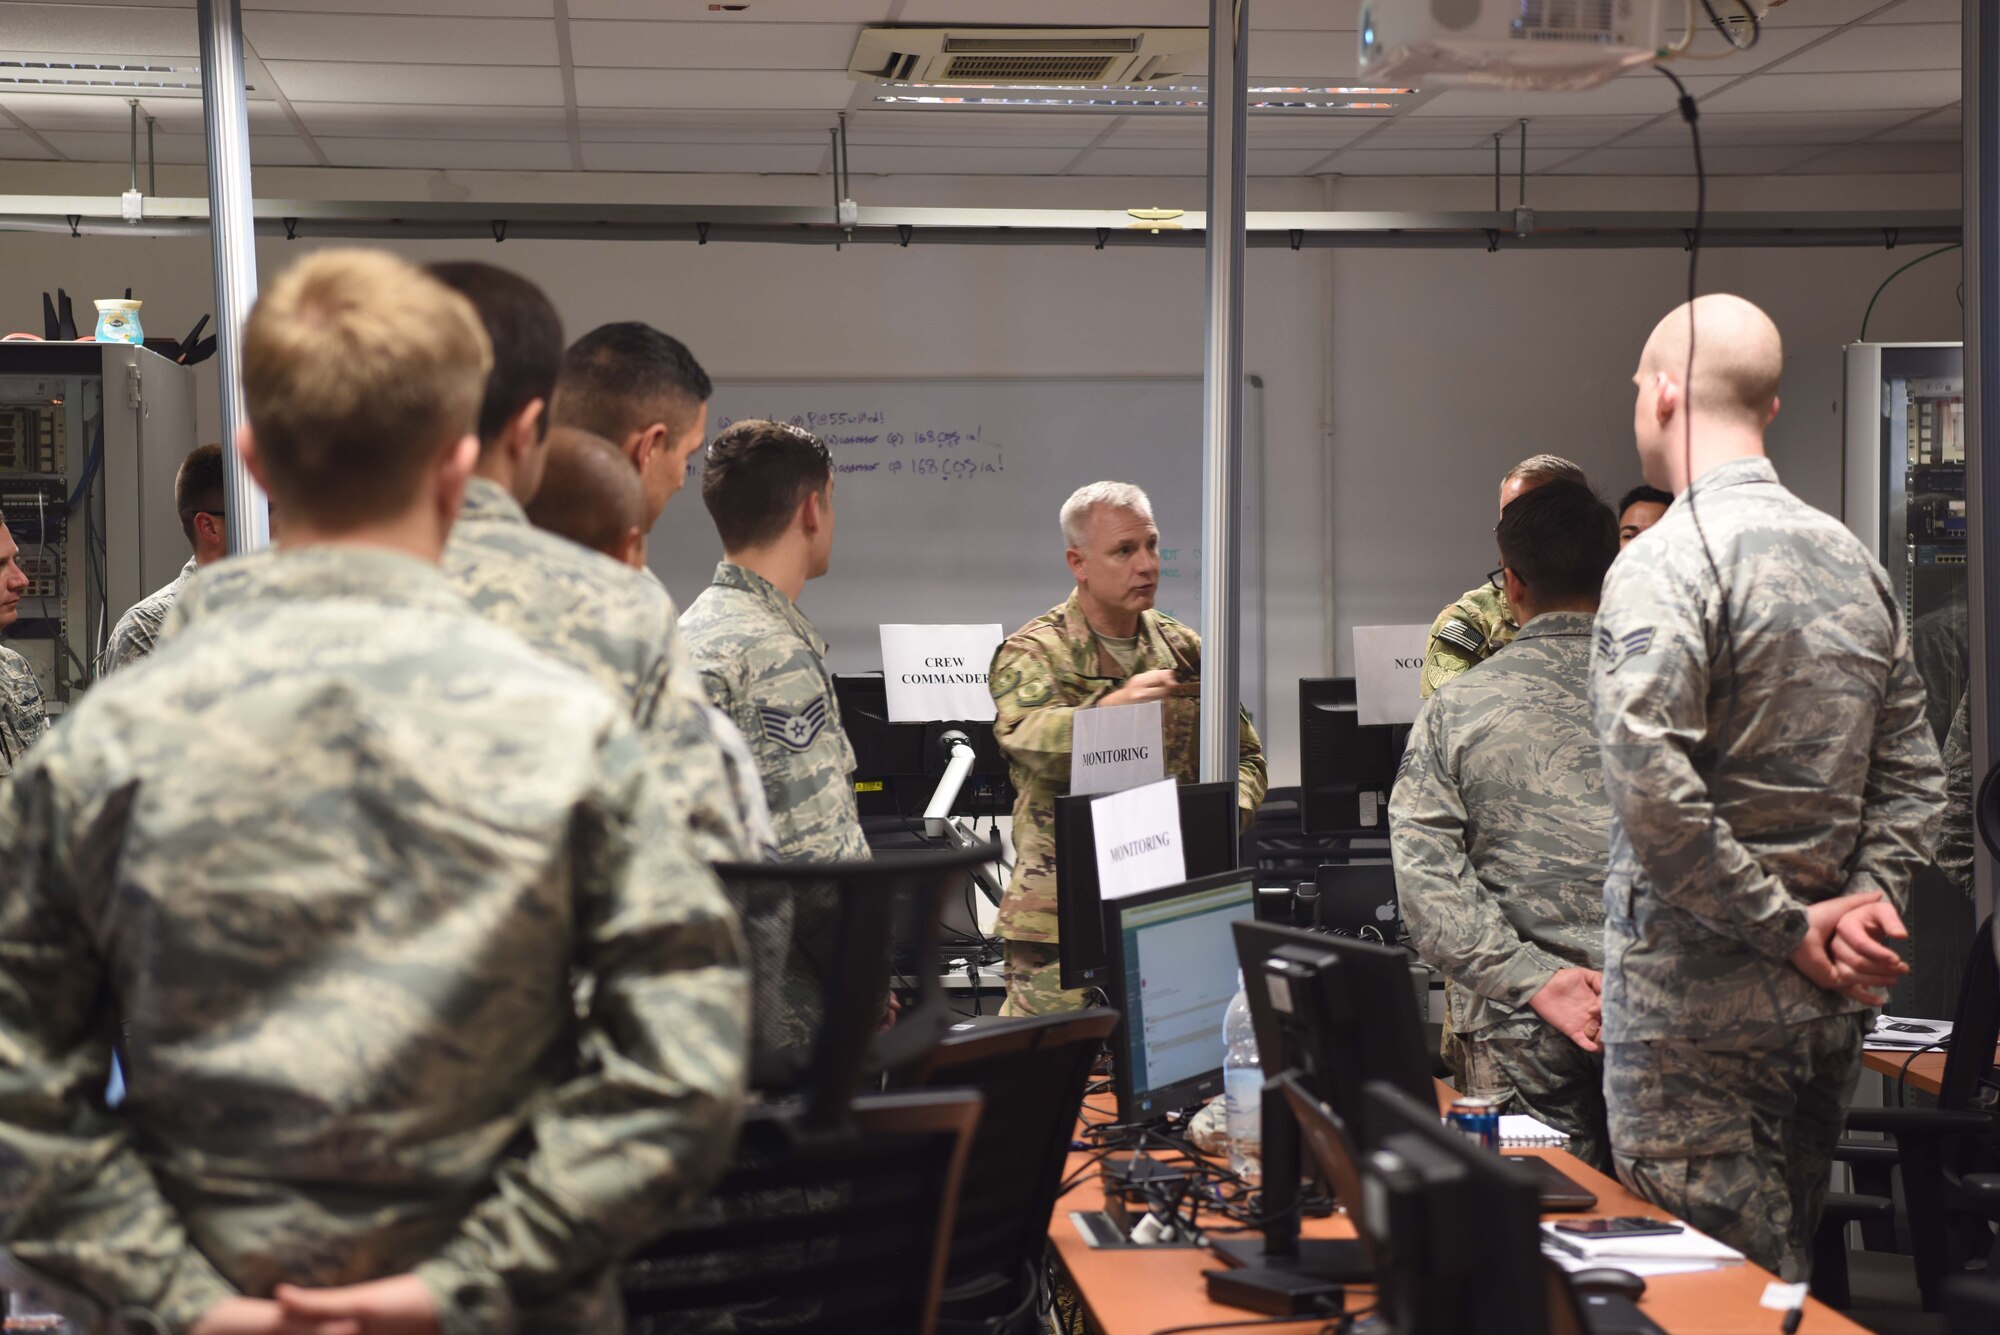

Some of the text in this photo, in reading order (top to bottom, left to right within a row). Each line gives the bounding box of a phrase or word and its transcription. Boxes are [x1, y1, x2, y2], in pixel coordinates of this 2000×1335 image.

[925, 657, 965, 668] CREW
[1394, 657, 1425, 670] NCO
[1082, 746, 1148, 767] MONITORING
[1110, 831, 1169, 864] MONITORING
